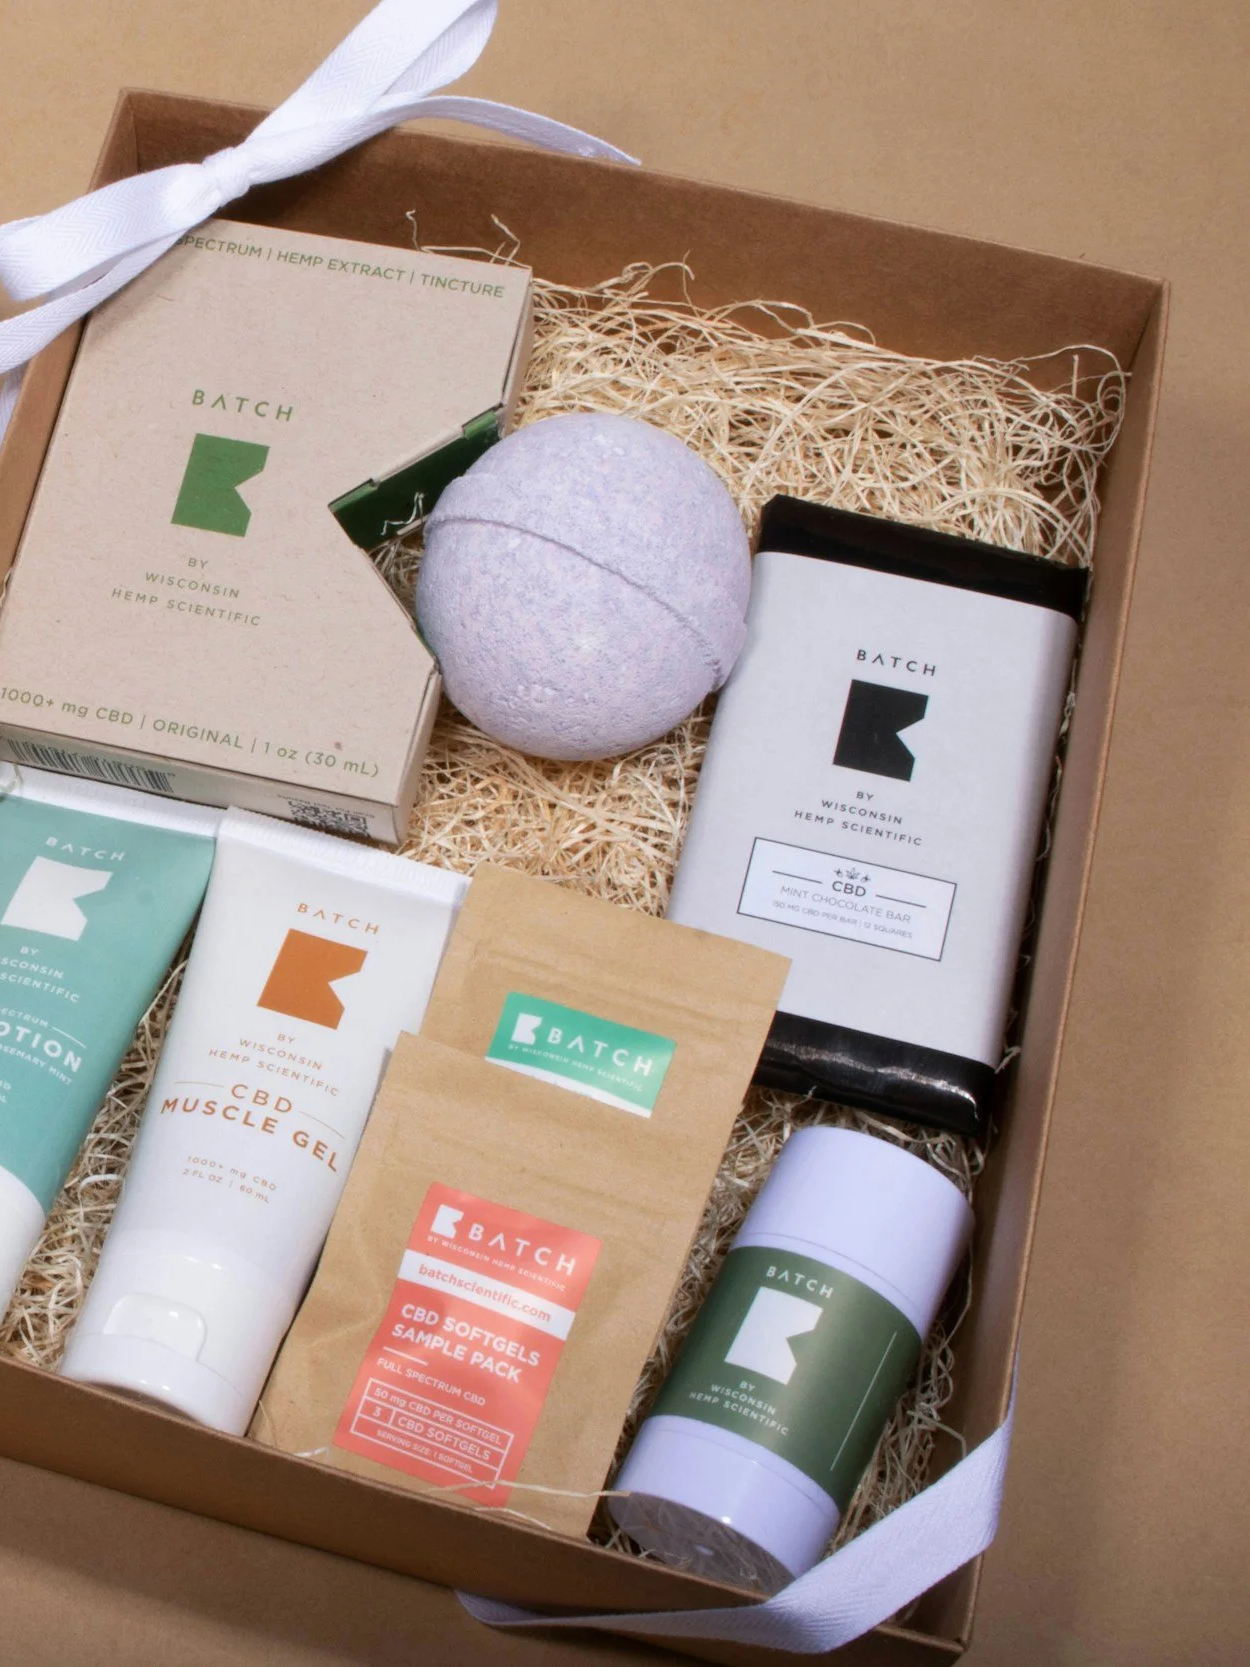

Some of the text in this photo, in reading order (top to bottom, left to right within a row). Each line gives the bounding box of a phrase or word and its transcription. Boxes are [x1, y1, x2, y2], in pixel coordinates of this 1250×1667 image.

[277, 251, 324, 267] HEMP
[327, 257, 407, 282] EXTRACT
[421, 273, 506, 299] TINCTURE
[192, 389, 293, 422] BATCH
[187, 557, 210, 569] BY
[145, 571, 240, 599] WISCONSIN
[111, 588, 262, 627] HEMP SCIENTIFIC
[856, 649, 936, 677] BATCH
[0, 687, 55, 707] 1000+
[61, 702, 89, 718] mg
[95, 707, 134, 725] CBD
[152, 719, 244, 749] ORIGINAL
[263, 742, 271, 754] 1
[277, 747, 299, 761] oz
[304, 751, 337, 768] (30
[342, 761, 380, 778] mL)
[821, 799, 903, 825] WISCONSIN
[856, 791, 874, 801] BY
[794, 810, 923, 847] HEMP SCIENTIFIC
[45, 836, 126, 862] BATCH
[780, 885, 912, 924] MINT CHOCOLATE BAR
[831, 880, 867, 898] CBD
[296, 902, 380, 935] BATCH
[19, 945, 39, 956] BY
[239, 1038, 323, 1071] WISCONSIN
[277, 1033, 296, 1044] BY
[546, 1026, 654, 1077] BATCH
[208, 1048, 340, 1097] HEMP SCIENTIFIC
[230, 1083, 293, 1114] CBD
[160, 1097, 338, 1173] MUSCLE GEL
[252, 1175, 278, 1191] CBD
[468, 1222, 576, 1276] BATCH
[418, 1263, 552, 1323] batchscientific.com
[765, 1265, 835, 1299] BATCH
[401, 1303, 541, 1367] CBD SOFTGELS
[391, 1323, 523, 1384] SAMPLE PACK
[376, 1357, 487, 1407] FULL SPECTRUM CBD
[739, 1380, 757, 1392] BY
[688, 1391, 790, 1437] HEMP SCIENTIFIC
[710, 1383, 777, 1416] WISCONSIN
[372, 1406, 491, 1461] 3 CBD SOFTGELS
[408, 1400, 432, 1416] CBD
[432, 1410, 455, 1425] PER
[455, 1418, 502, 1446] SOFTGEL
